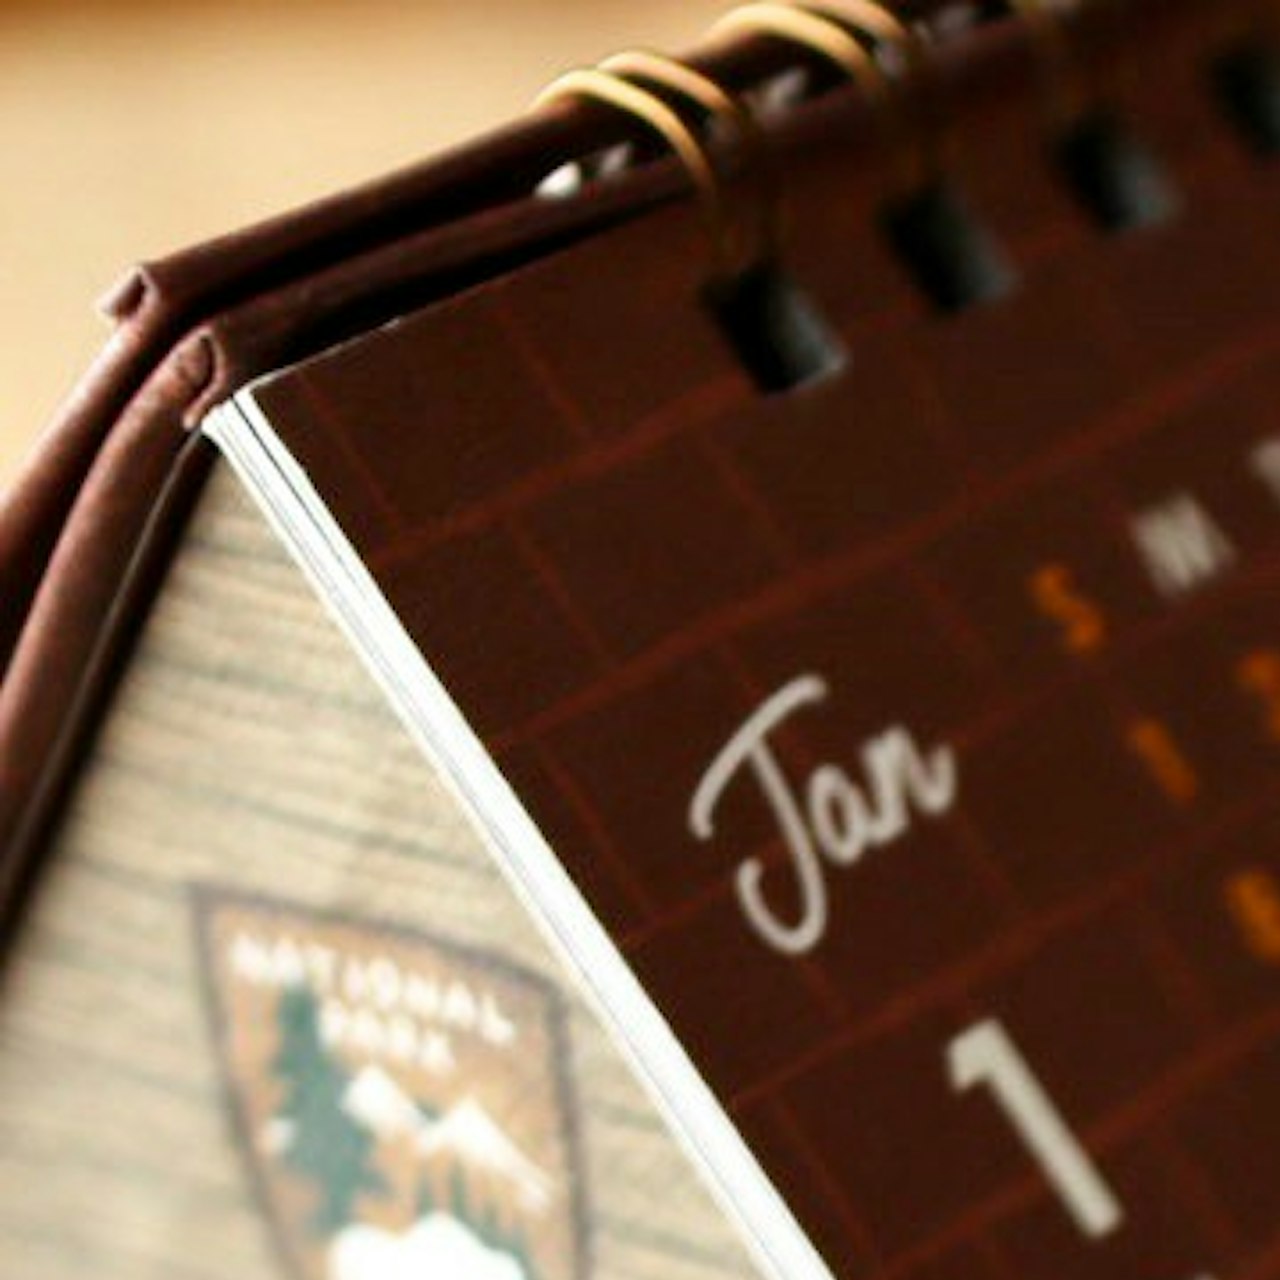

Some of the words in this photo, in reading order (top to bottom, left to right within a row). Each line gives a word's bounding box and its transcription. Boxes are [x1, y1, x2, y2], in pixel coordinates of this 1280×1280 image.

[1032, 565, 1103, 653] S
[1136, 499, 1228, 588] M
[688, 673, 957, 955] Jan
[1126, 718, 1196, 802] 1
[228, 933, 518, 1048] NATIONAL
[945, 1017, 1123, 1239] 1
